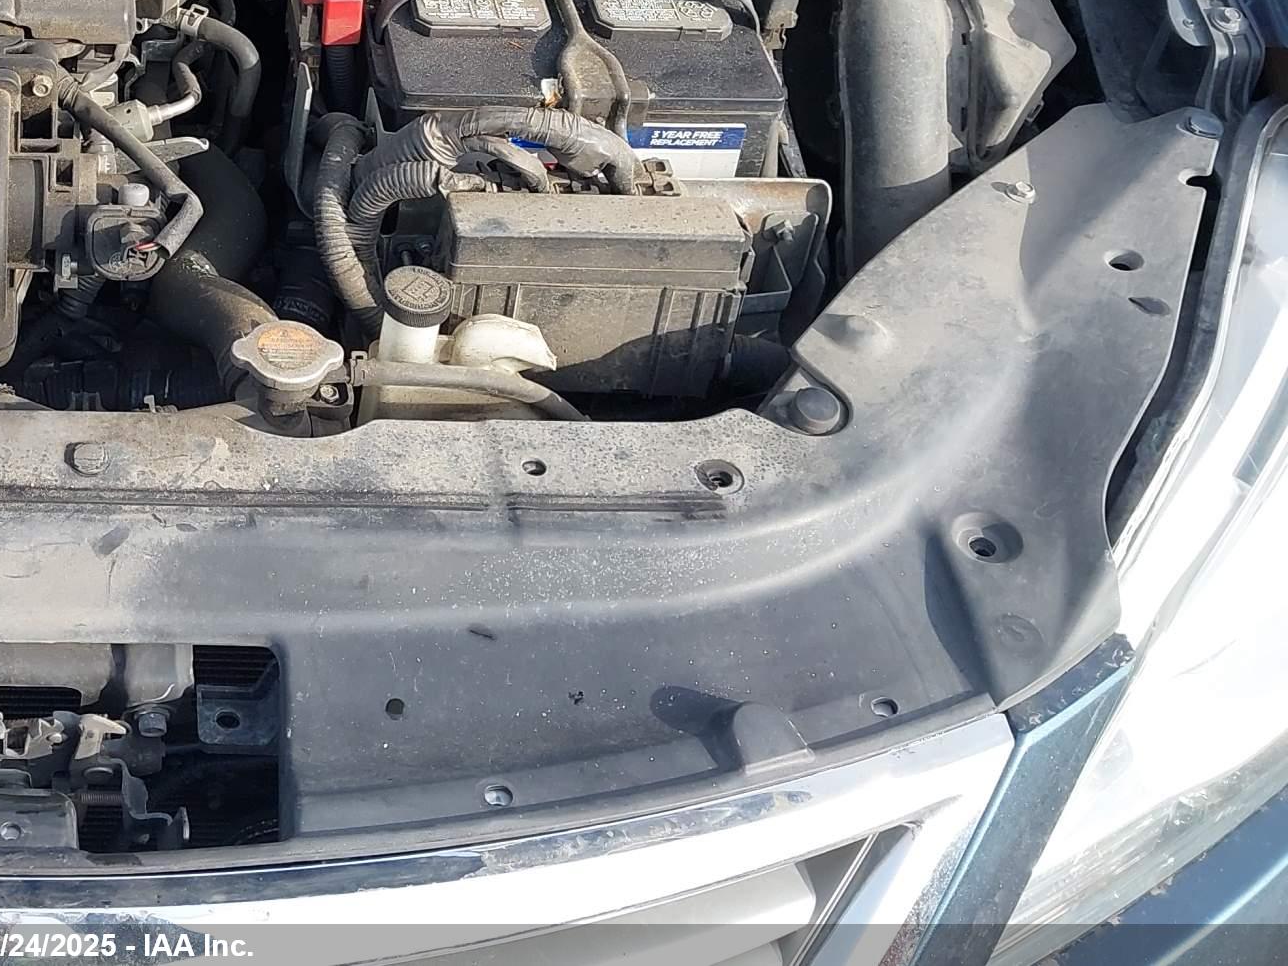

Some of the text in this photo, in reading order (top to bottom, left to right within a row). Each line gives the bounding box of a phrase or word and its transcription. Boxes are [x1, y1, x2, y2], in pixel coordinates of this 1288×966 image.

[651, 130, 724, 139] 3 YEAR FREE
